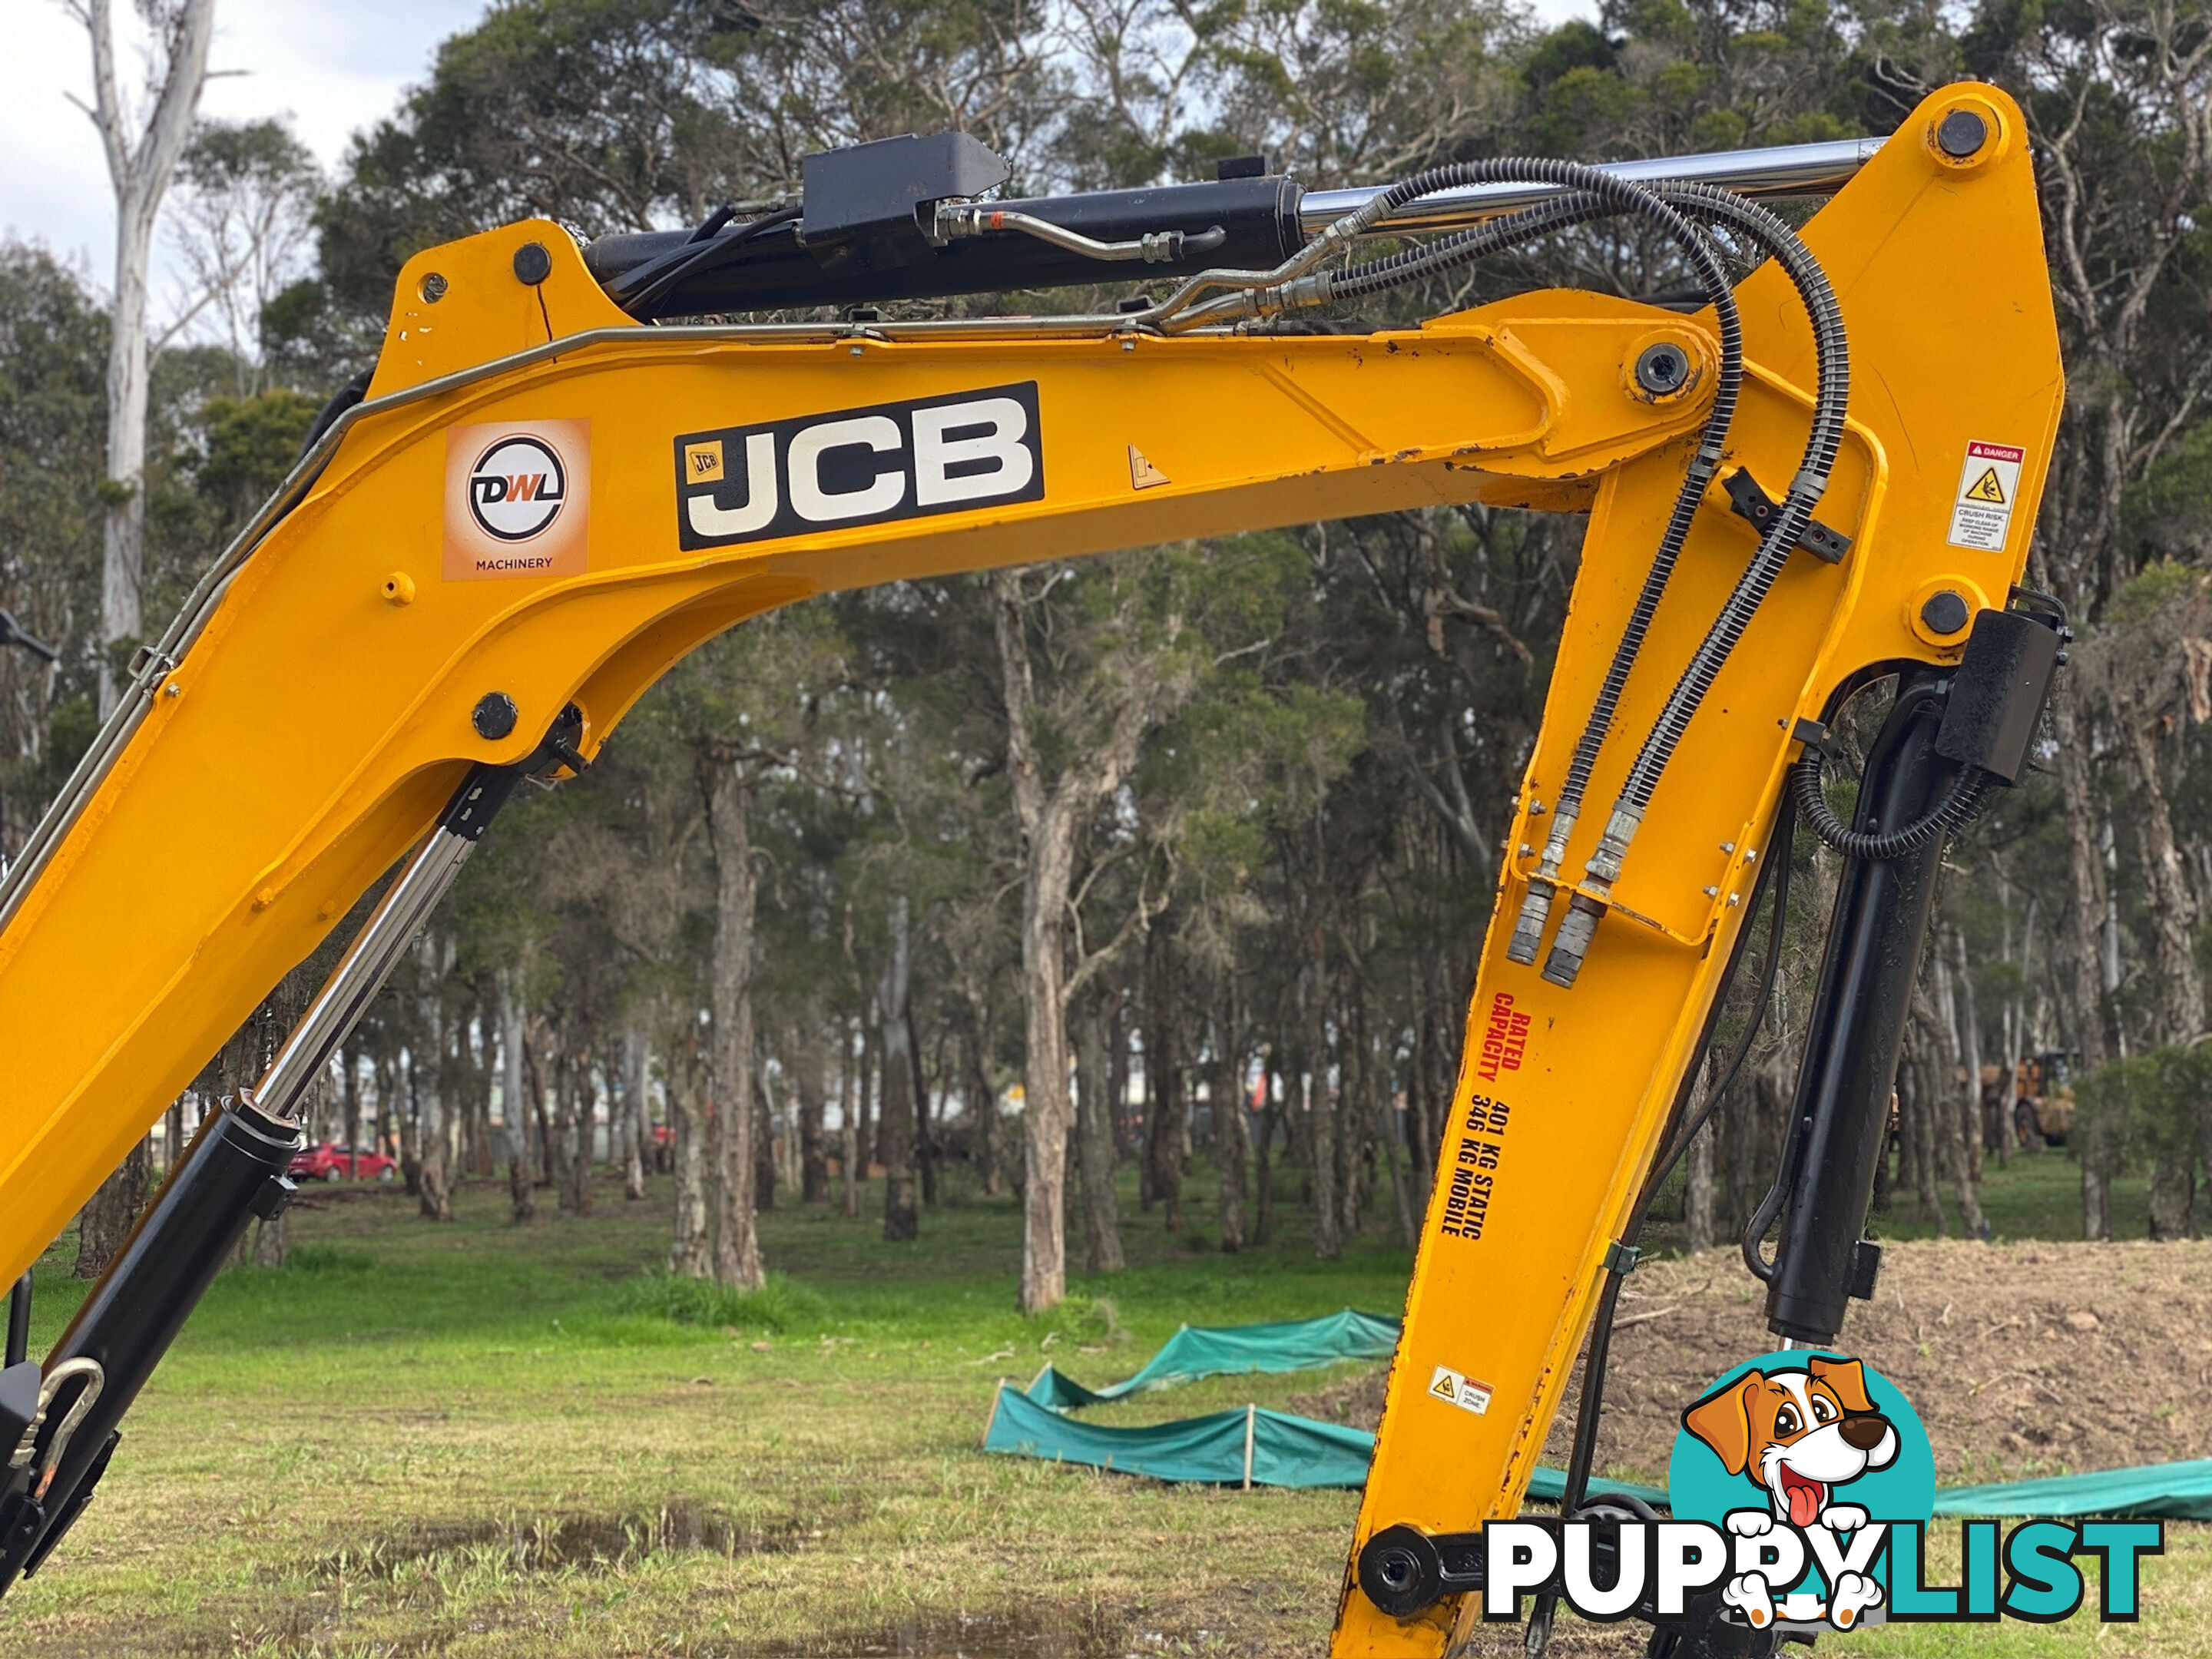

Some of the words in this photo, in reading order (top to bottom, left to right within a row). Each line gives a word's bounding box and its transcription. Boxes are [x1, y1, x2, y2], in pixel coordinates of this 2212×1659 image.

[688, 397, 1033, 537] JCB
[695, 454, 717, 472] JCB
[1983, 448, 2019, 460] DANGER
[470, 473, 563, 504] DWL
[1959, 509, 1985, 518] CRUSH
[1985, 513, 2004, 522] RISK.
[476, 558, 553, 571] MACHINERY
[1478, 992, 1515, 1083] CAPACITY
[1502, 1012, 1532, 1071] RATED
[1465, 1094, 1491, 1133] 346
[1486, 1101, 1511, 1137] 401
[1458, 1137, 1481, 1165] KG
[1478, 1142, 1502, 1171] KG
[1441, 1167, 1474, 1237] MOBILE
[1462, 1174, 1493, 1241] STATIC
[1465, 1390, 1485, 1402] CRUSH
